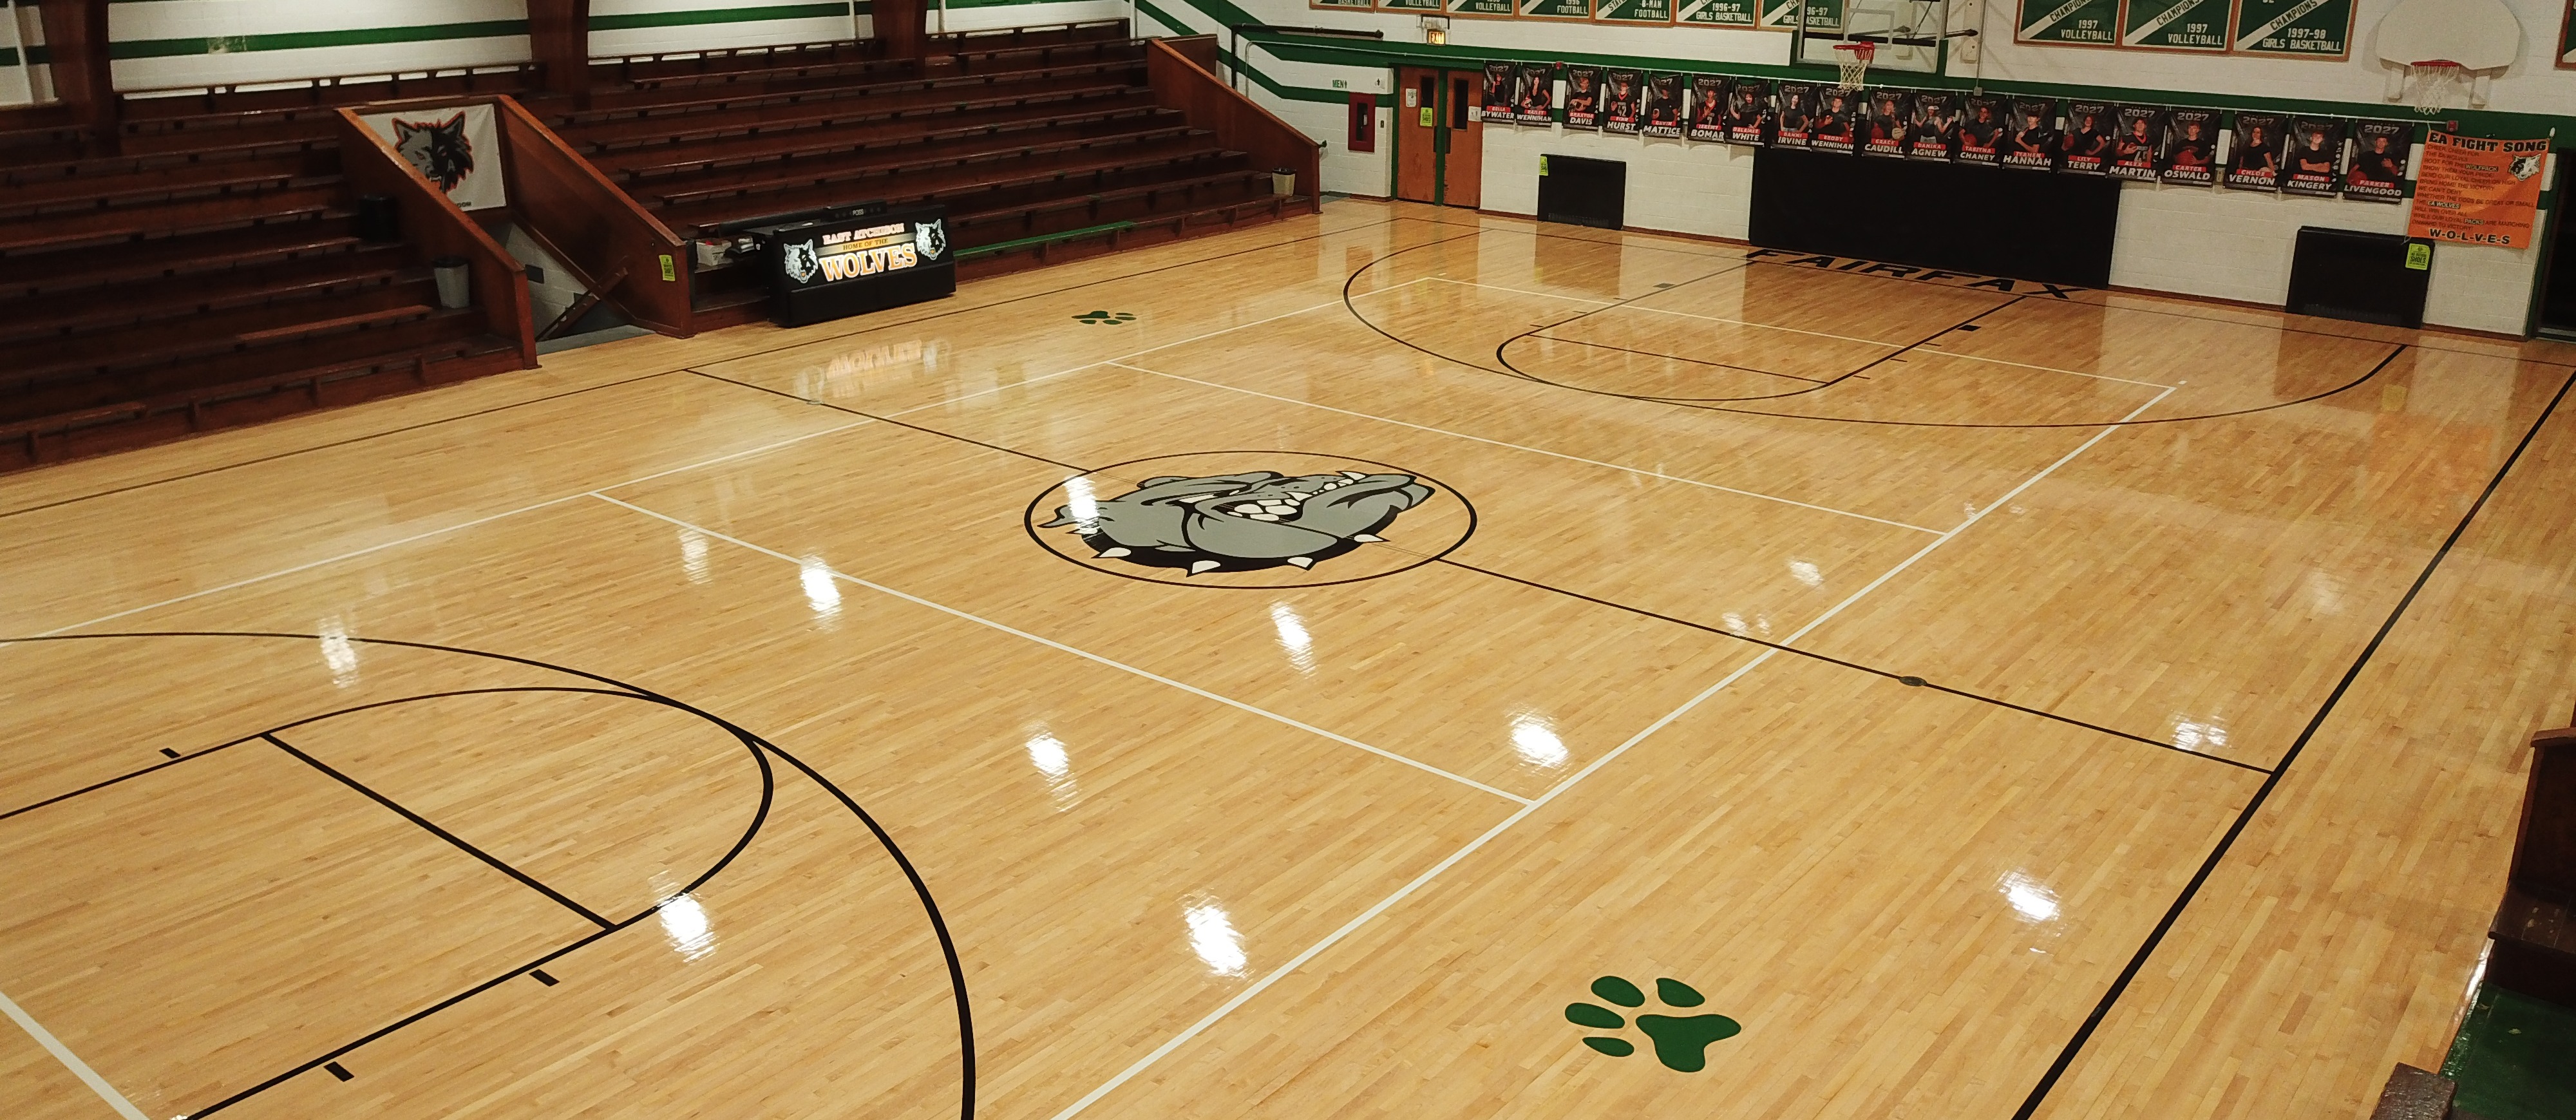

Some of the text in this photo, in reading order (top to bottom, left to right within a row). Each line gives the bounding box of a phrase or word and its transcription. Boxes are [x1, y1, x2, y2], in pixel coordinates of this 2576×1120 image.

[1475, 3, 1511, 11] VOLLEYBALL
[1557, 5, 1587, 14] FOOTBALL
[1712, 3, 1740, 12] 1996-97
[1634, 9, 1668, 18] FOOTBALL
[1696, 12, 1752, 22] GIRLS BASKETBALL
[2269, 0, 2318, 30] CHAMPIONS
[1806, 17, 1839, 26] ASKETBALL
[2078, 20, 2098, 29] 1997
[2187, 23, 2208, 33] 1997
[1431, 32, 1443, 44] EXIT
[2061, 30, 2112, 41] VOLLEYBALL
[2287, 28, 2326, 39] 1997-98
[2168, 33, 2222, 45] VOLLEYBALL
[2262, 38, 2341, 51] GIRLS BASKETBALL
[1332, 80, 1344, 88] MEN
[1785, 85, 1810, 93] 2027
[1877, 91, 1902, 100] 2027
[2075, 104, 2105, 114] 2027
[2125, 108, 2155, 118] 2027
[1481, 110, 1514, 119] BYWATER
[2177, 112, 2210, 121] 2027
[1607, 121, 1636, 130] HURST
[2242, 116, 2275, 126] 2027
[1643, 125, 1681, 135] MATTICE
[1691, 129, 1725, 139] BOMAR
[2364, 124, 2400, 135] 2027
[1732, 133, 1759, 141] WHITE
[1778, 137, 1806, 146] IRVINE
[1812, 140, 1854, 150] WENNIHAN
[2429, 132, 2546, 153] EA FIGHT SONG
[1864, 144, 1904, 154] CAUDILL
[1911, 147, 1947, 157] AGNEW
[1960, 152, 1995, 161] CHANEY
[2003, 155, 2052, 166] HANNAH
[2068, 160, 2100, 170] TERRY
[2108, 166, 2156, 178] MARTIN
[2164, 169, 2210, 180] OSWALD
[2229, 175, 2275, 185] VERNON
[2297, 174, 2325, 182] MASON
[2287, 180, 2333, 191] KINGERY
[2358, 180, 2390, 188] PARKER
[2344, 185, 2402, 196] LIVENGOOD
[822, 222, 905, 245] EAST ATCHISON
[2429, 228, 2510, 245] W-O-L-V-E-S
[842, 242, 863, 251] HOME
[819, 243, 917, 281] WOLVES
[1746, 248, 2088, 299] FAIRFAX
